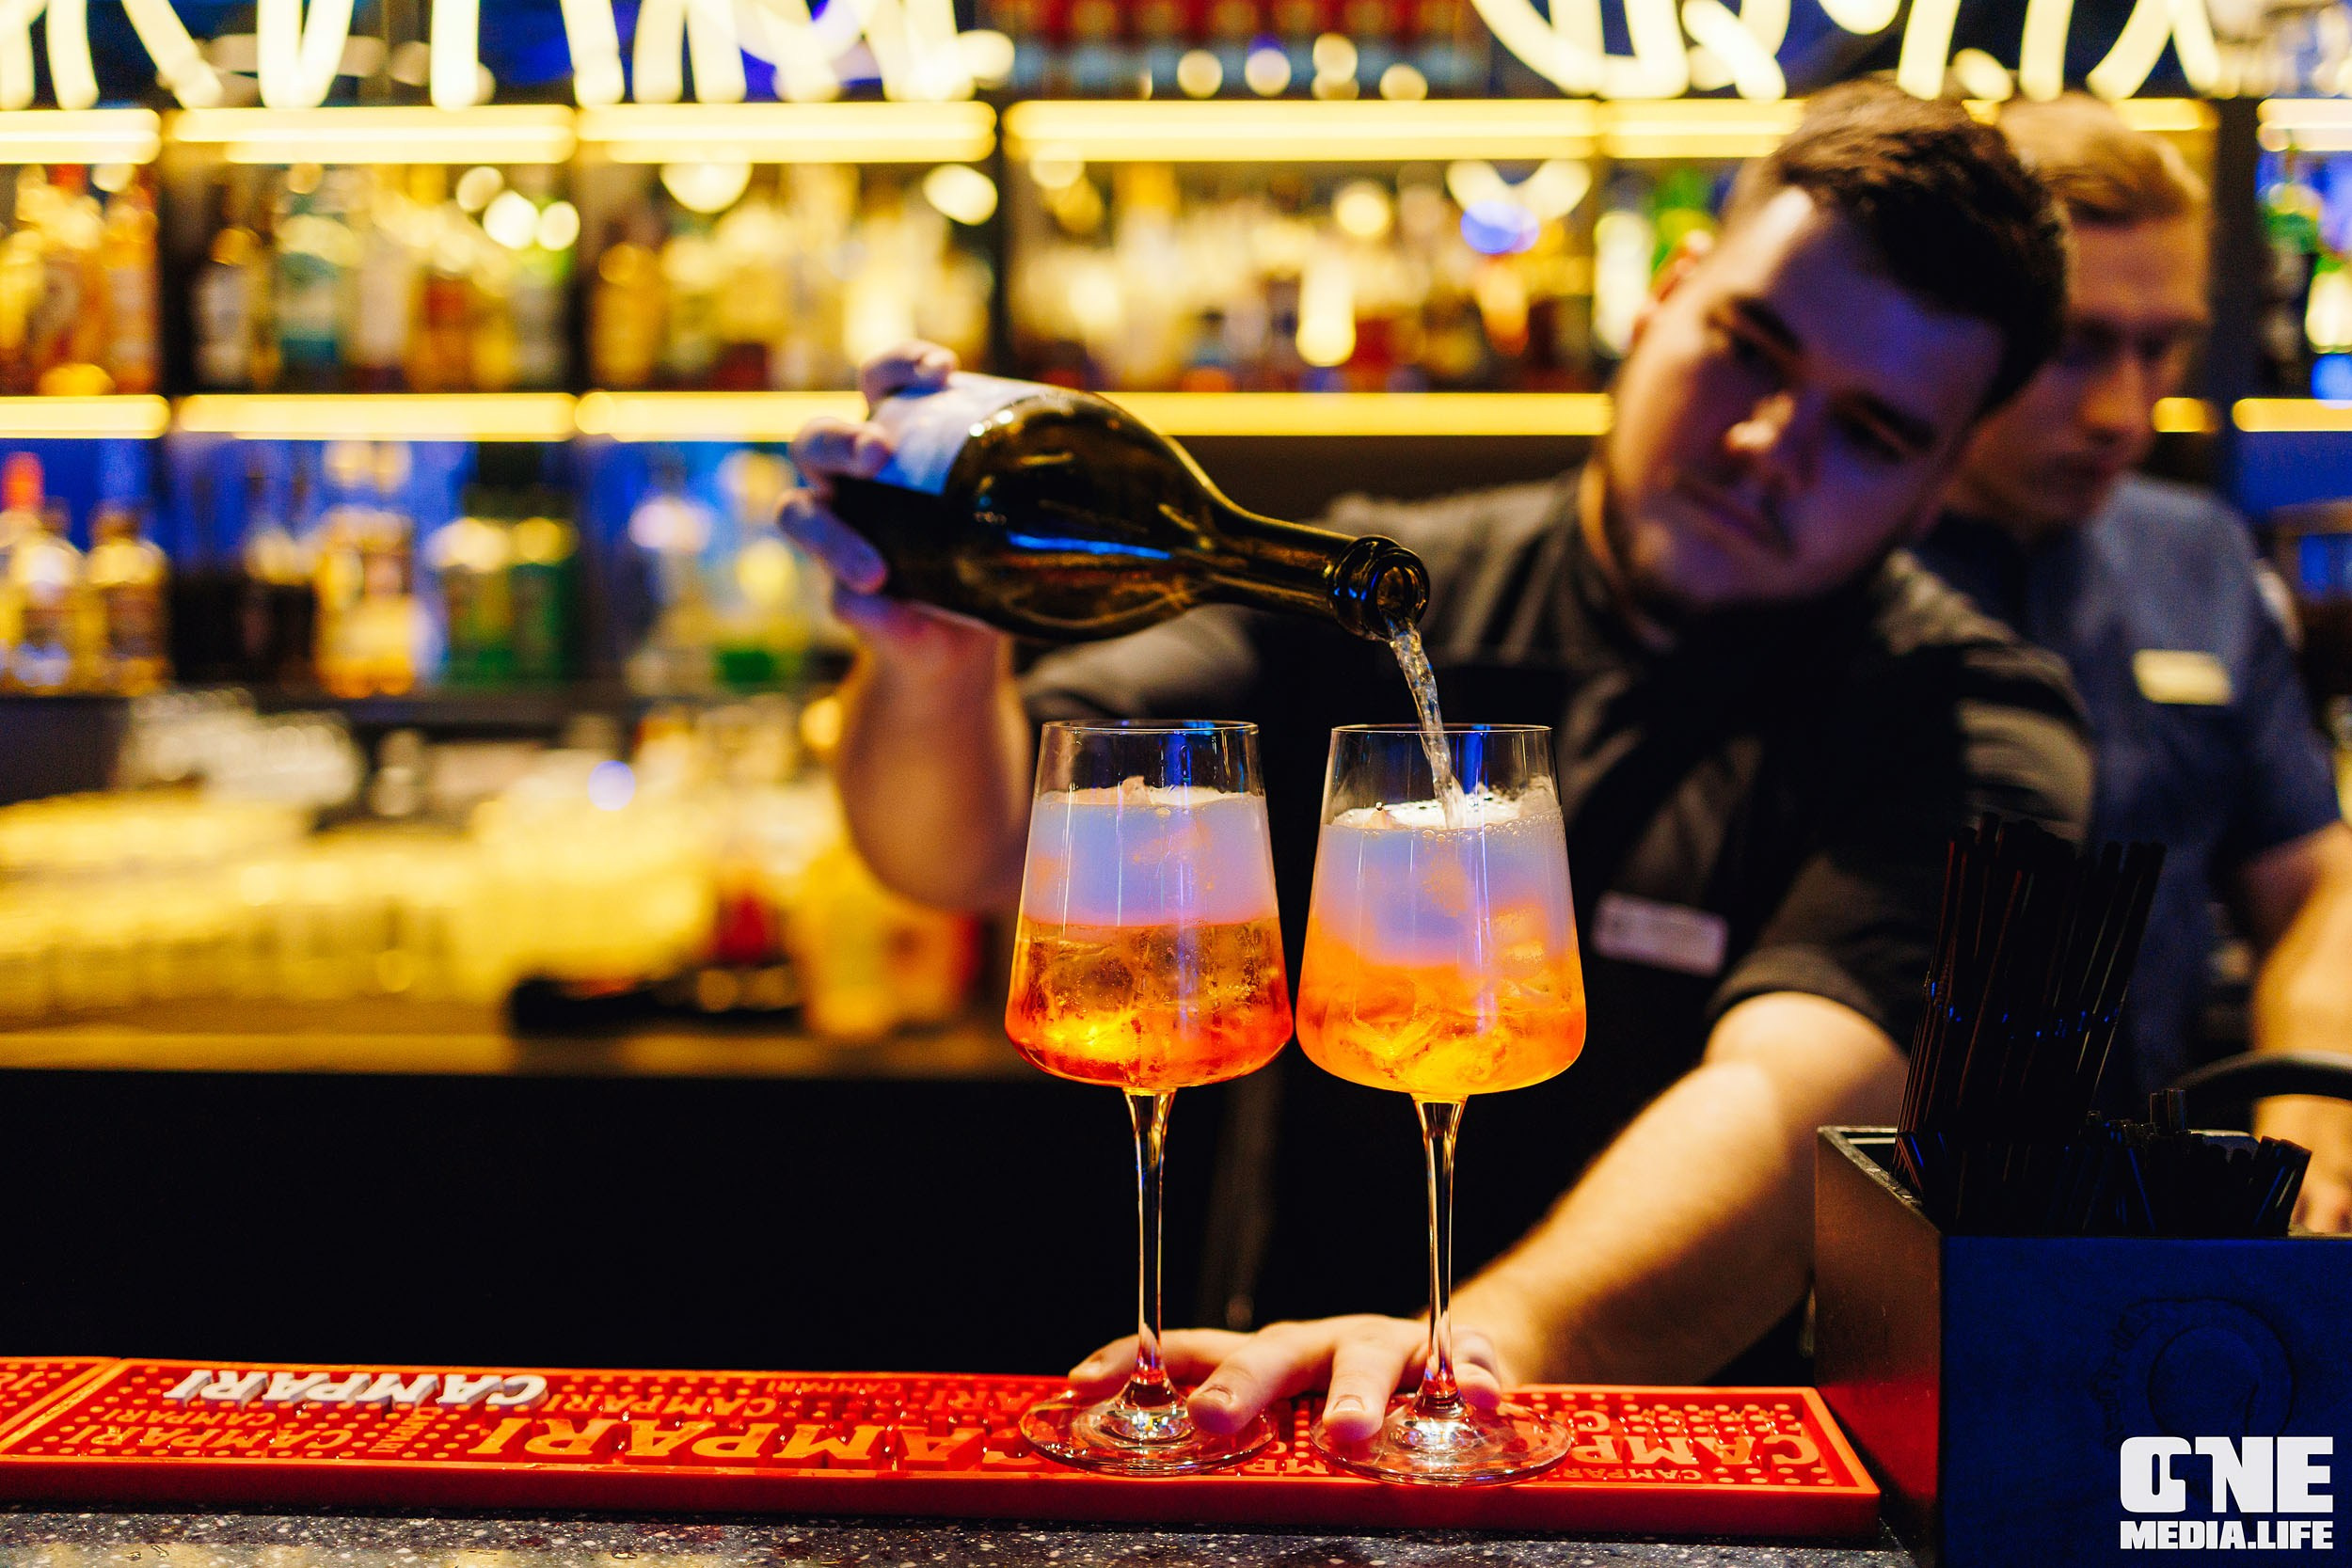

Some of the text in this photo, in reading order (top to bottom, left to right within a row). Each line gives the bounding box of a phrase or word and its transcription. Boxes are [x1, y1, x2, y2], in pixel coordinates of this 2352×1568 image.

[163, 1370, 548, 1405] CAMPARI
[765, 1379, 901, 1395] CAMPARI
[101, 1409, 276, 1425] CAMPARI
[542, 1393, 777, 1418] CAMPARI
[62, 1424, 353, 1450] CAMPARI
[467, 1418, 1043, 1465] CAMPARI
[1572, 1434, 1820, 1465] CAMP
